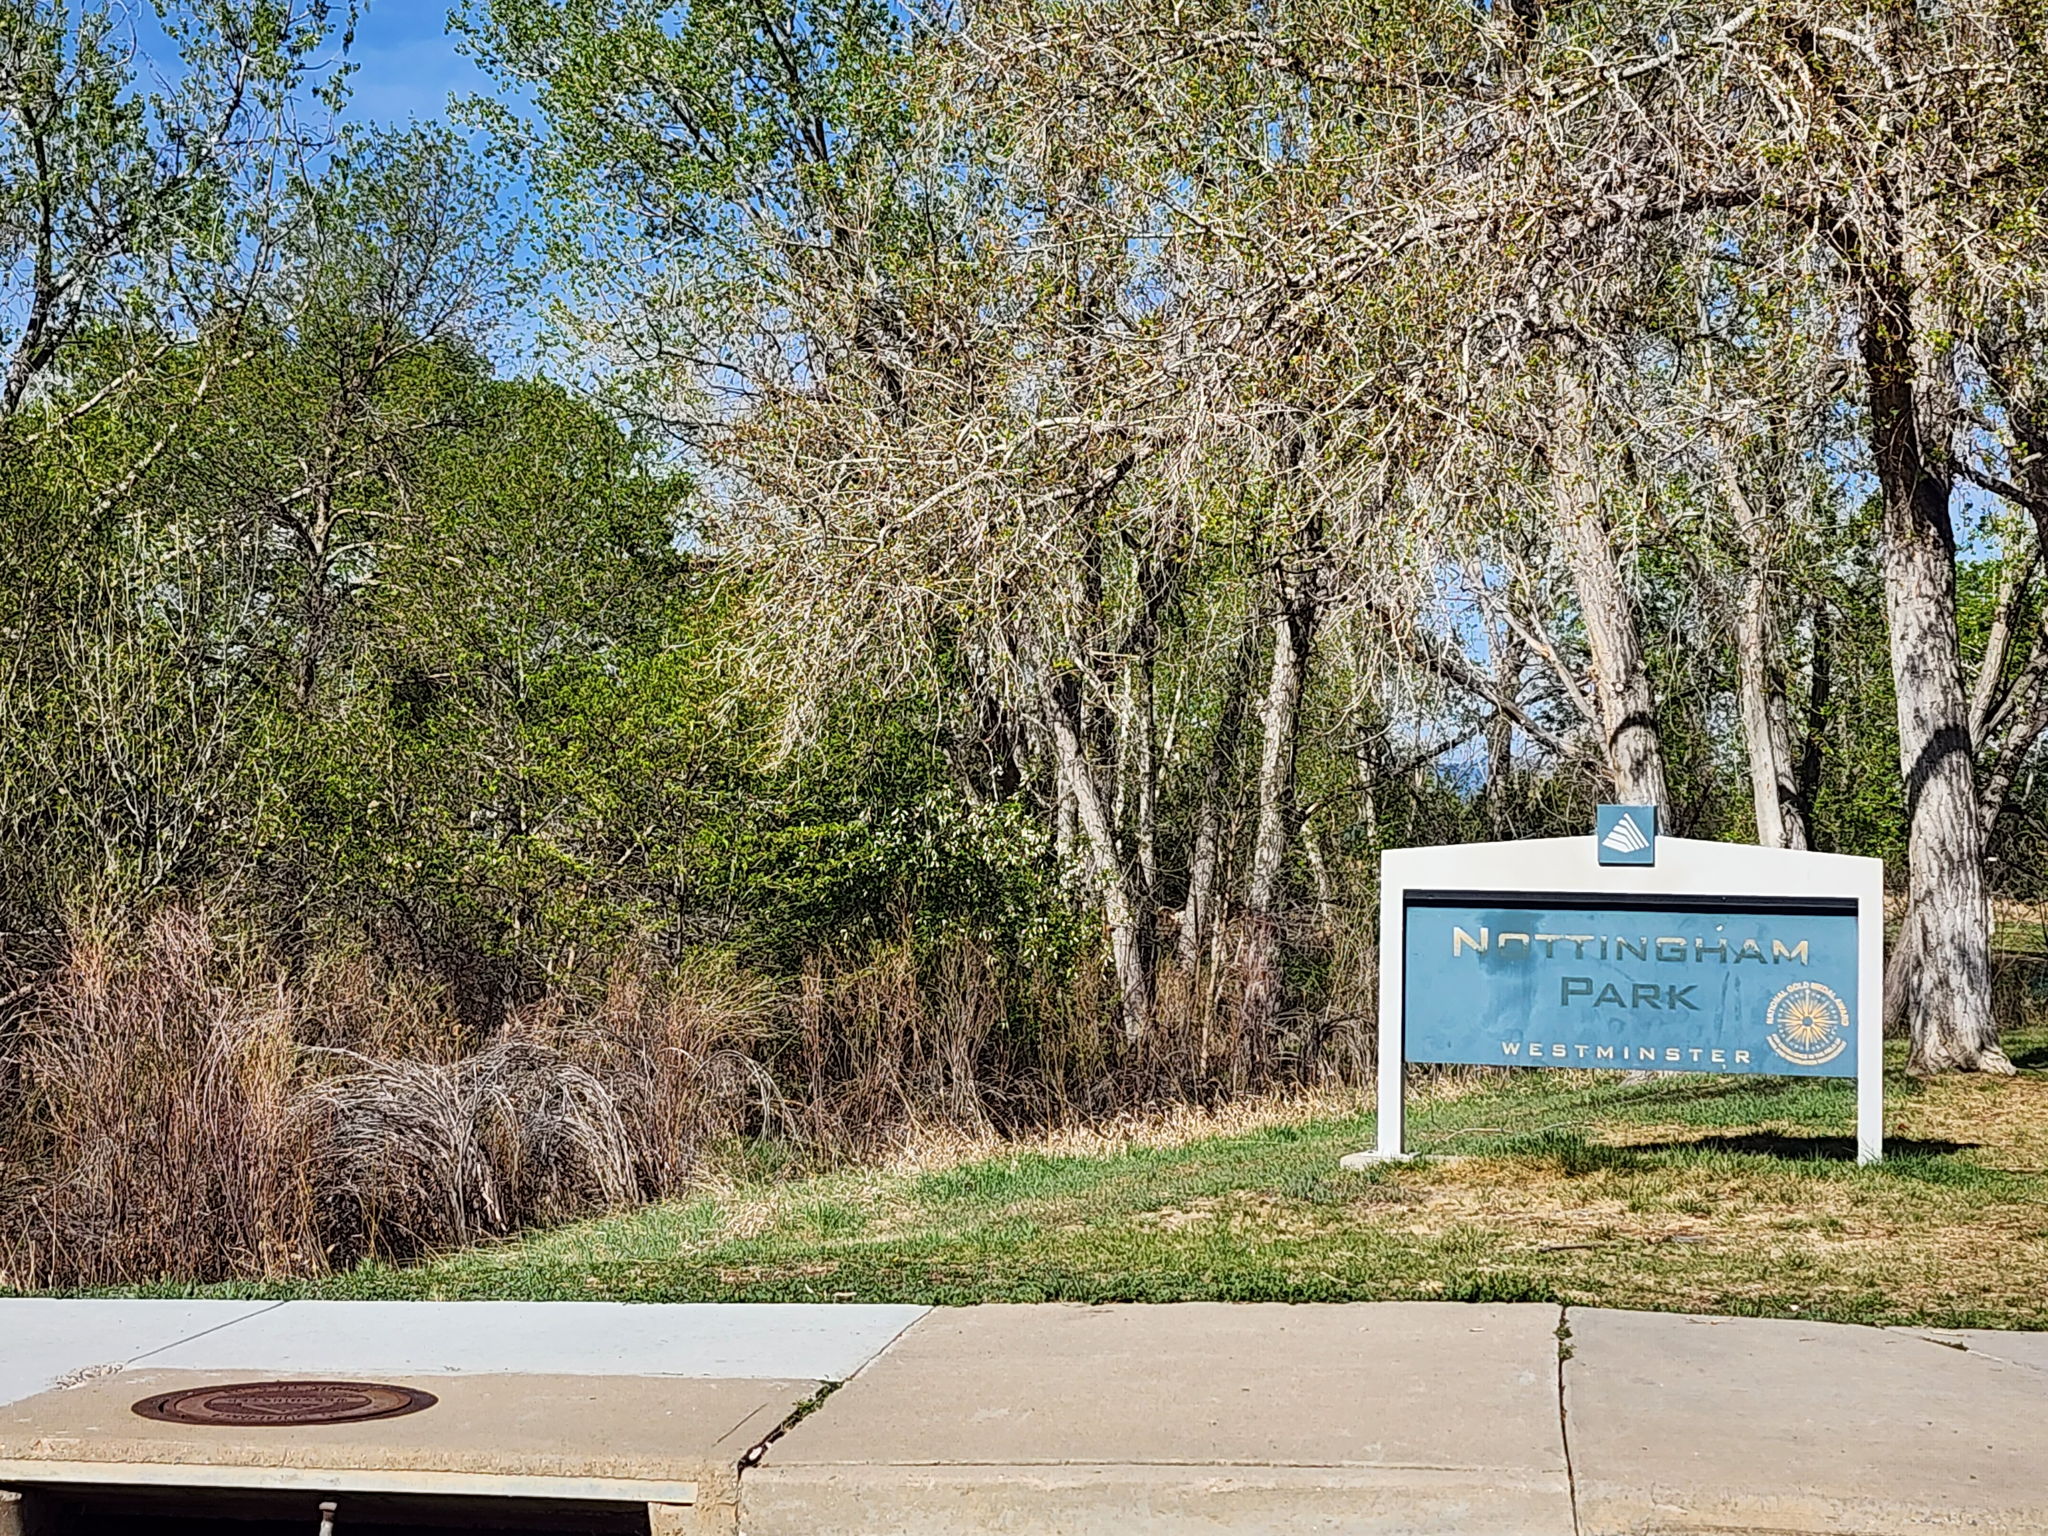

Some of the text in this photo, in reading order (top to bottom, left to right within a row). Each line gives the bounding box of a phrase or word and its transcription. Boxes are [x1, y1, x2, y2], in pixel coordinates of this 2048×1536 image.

[1452, 926, 1809, 966] NOTTINGHAM
[1561, 977, 1700, 1011] PARK
[1786, 981, 1810, 992] GOLD
[1502, 1041, 1752, 1064] WESTMINSTER
